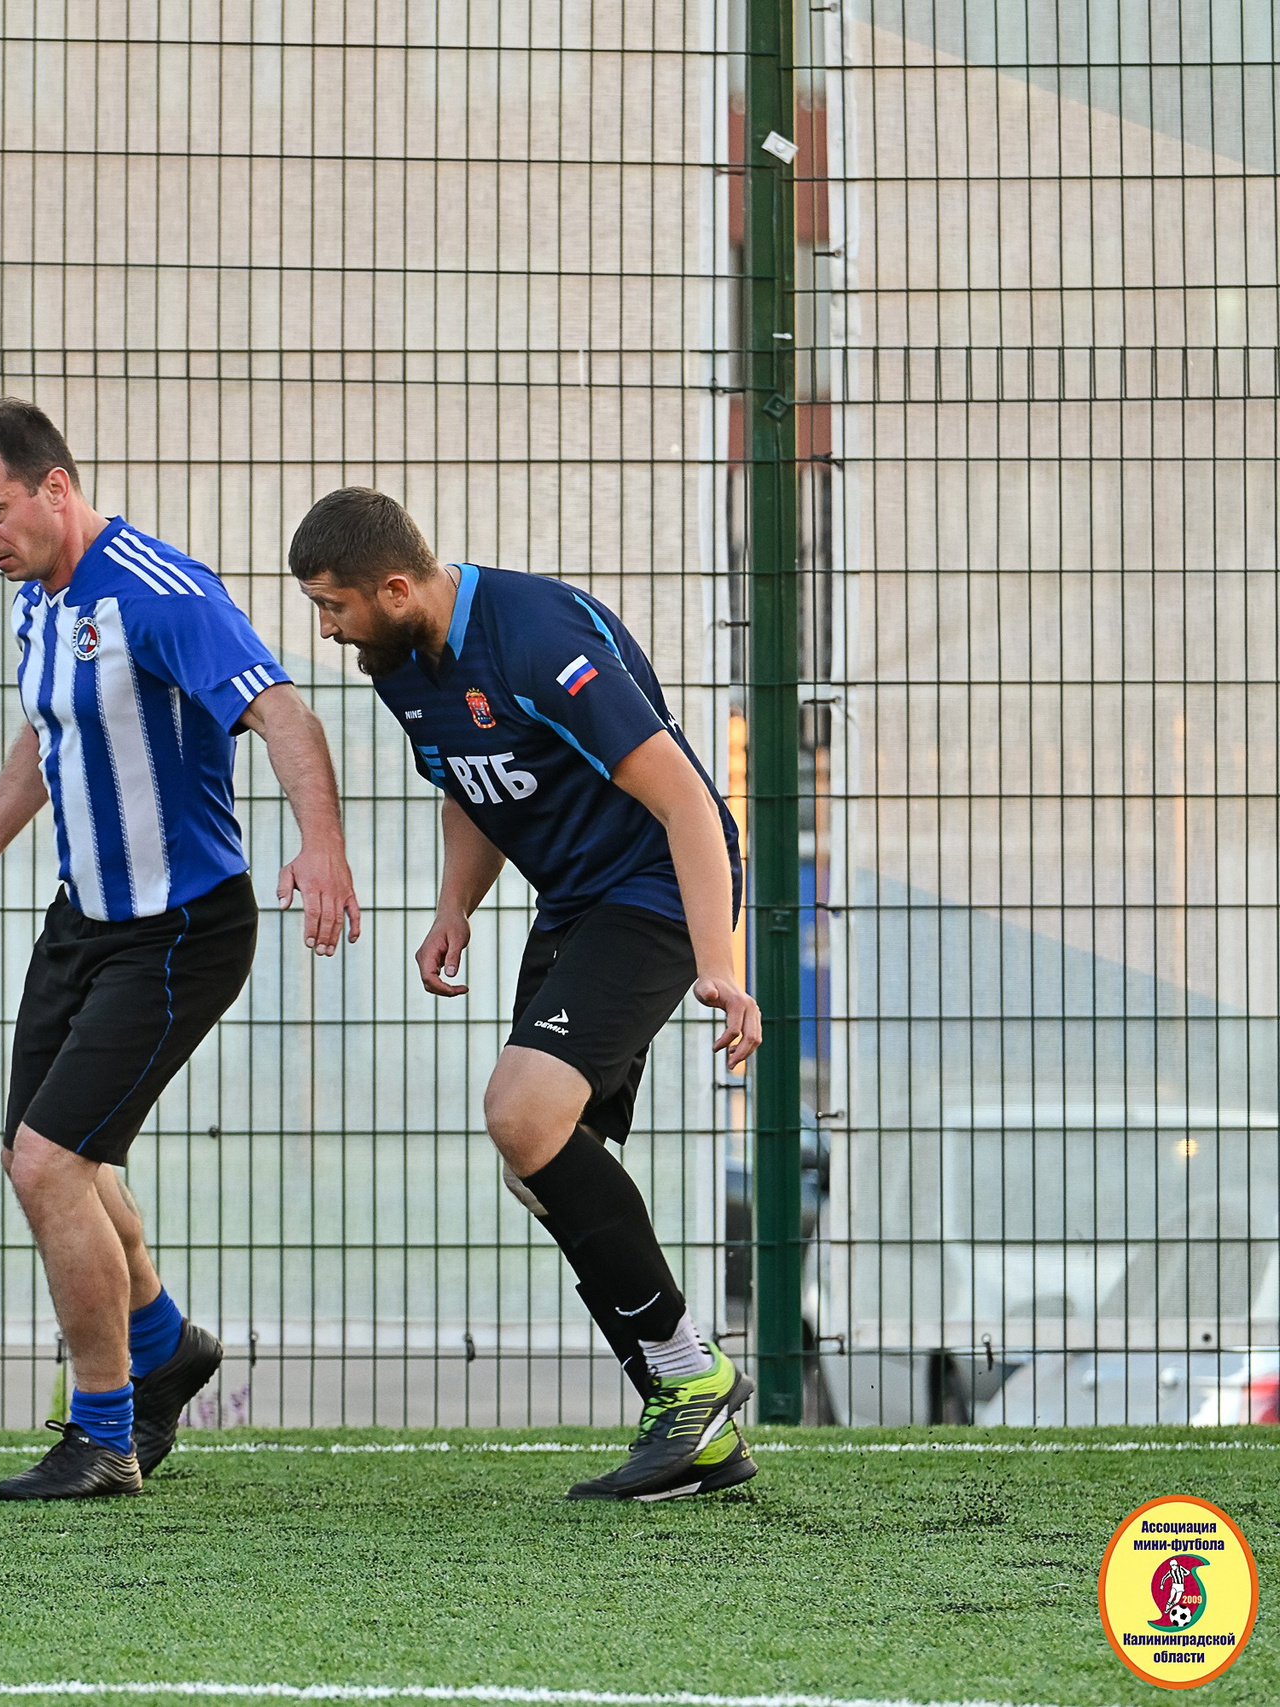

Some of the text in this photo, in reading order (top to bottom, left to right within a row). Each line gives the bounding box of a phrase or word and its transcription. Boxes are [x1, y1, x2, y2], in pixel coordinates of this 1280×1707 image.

[405, 709, 423, 719] NINE
[447, 752, 538, 804] ВТБ
[534, 1020, 569, 1036] DEMIX
